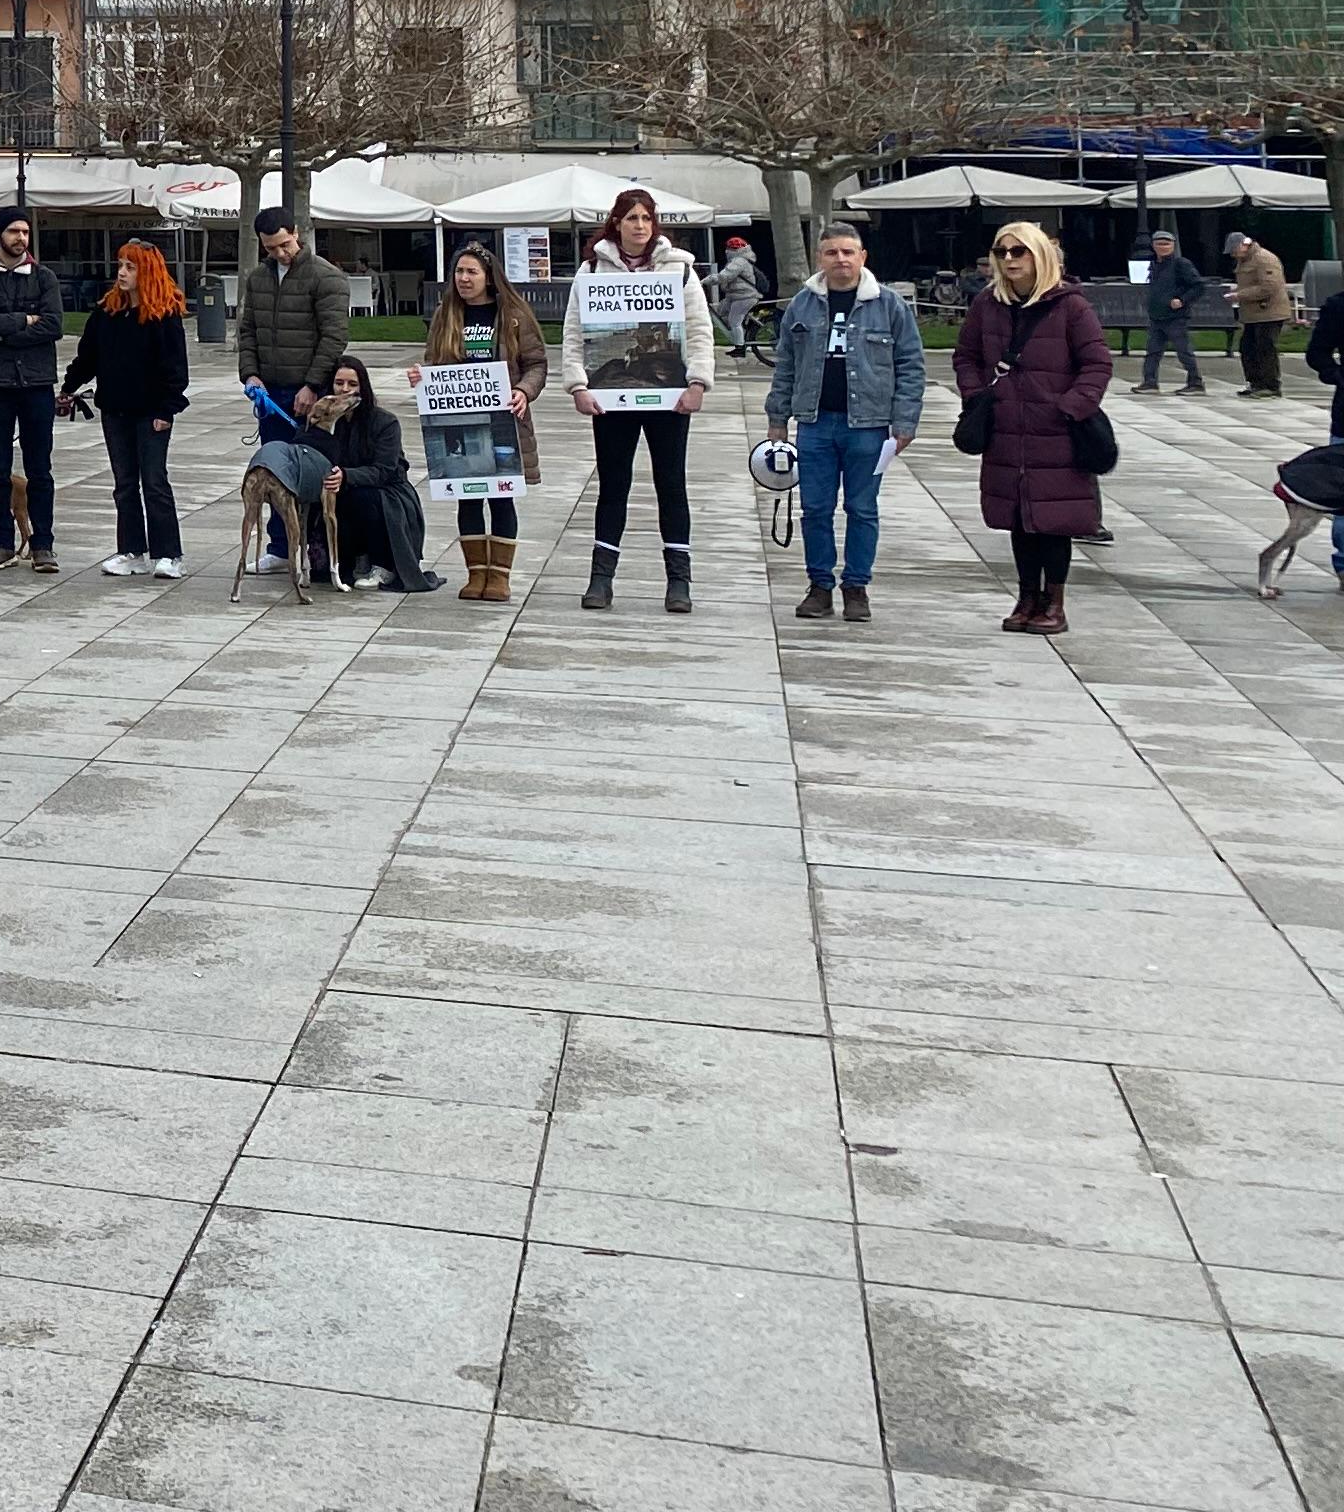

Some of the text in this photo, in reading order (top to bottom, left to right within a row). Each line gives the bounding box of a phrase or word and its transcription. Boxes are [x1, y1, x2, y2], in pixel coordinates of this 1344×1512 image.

[193, 207, 218, 217] BAR
[588, 280, 673, 297] PROTECCIÓN
[588, 298, 675, 312] PARA TODOS
[430, 368, 490, 383] MERECEN
[424, 381, 501, 396] IGUALDAD DE
[428, 395, 501, 410] DERECHOS
